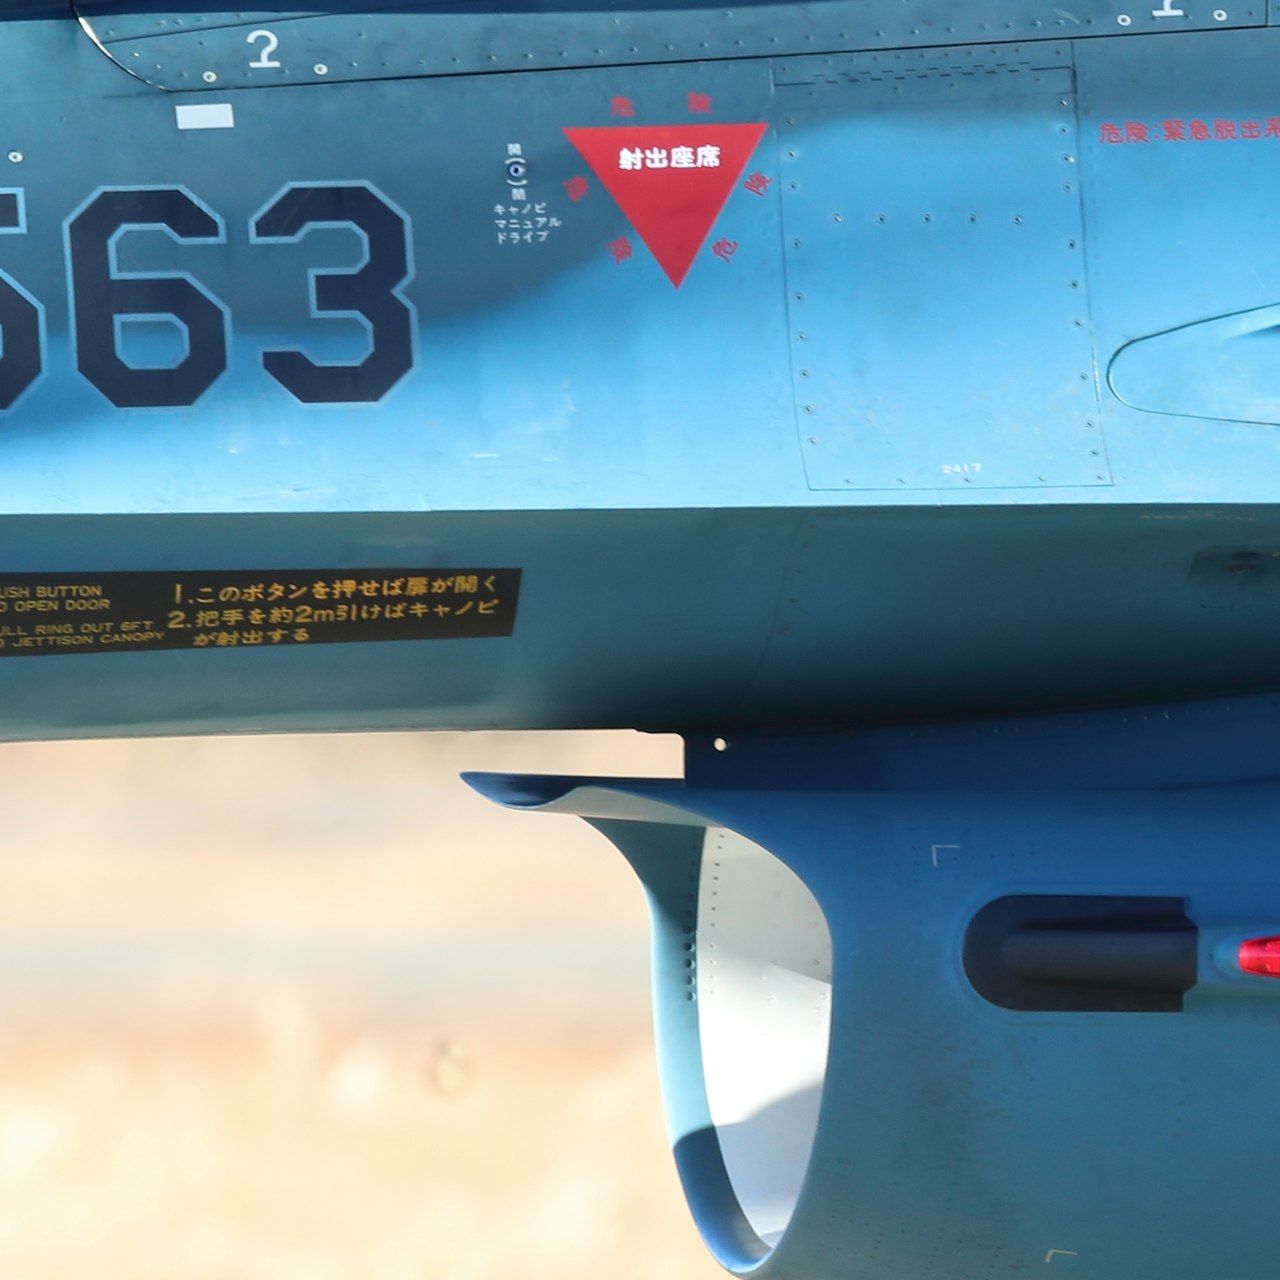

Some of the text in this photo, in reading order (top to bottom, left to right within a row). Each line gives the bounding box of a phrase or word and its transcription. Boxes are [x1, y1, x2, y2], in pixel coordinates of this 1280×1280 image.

[246, 29, 281, 68] 2
[618, 145, 721, 171] 射出座席
[494, 216, 563, 229] マニュアル
[497, 230, 550, 244] ドライブ
[941, 462, 982, 474] 2417
[35, 585, 103, 598] BUTTON
[14, 600, 59, 612] OPEN
[65, 598, 111, 611] DOOR
[35, 623, 73, 635] RING
[80, 622, 114, 634] OUT
[120, 620, 155, 632] 6FT
[12, 634, 94, 648] JETTISON
[100, 631, 166, 644] CANOPY
[193, 628, 310, 648] が射出する
